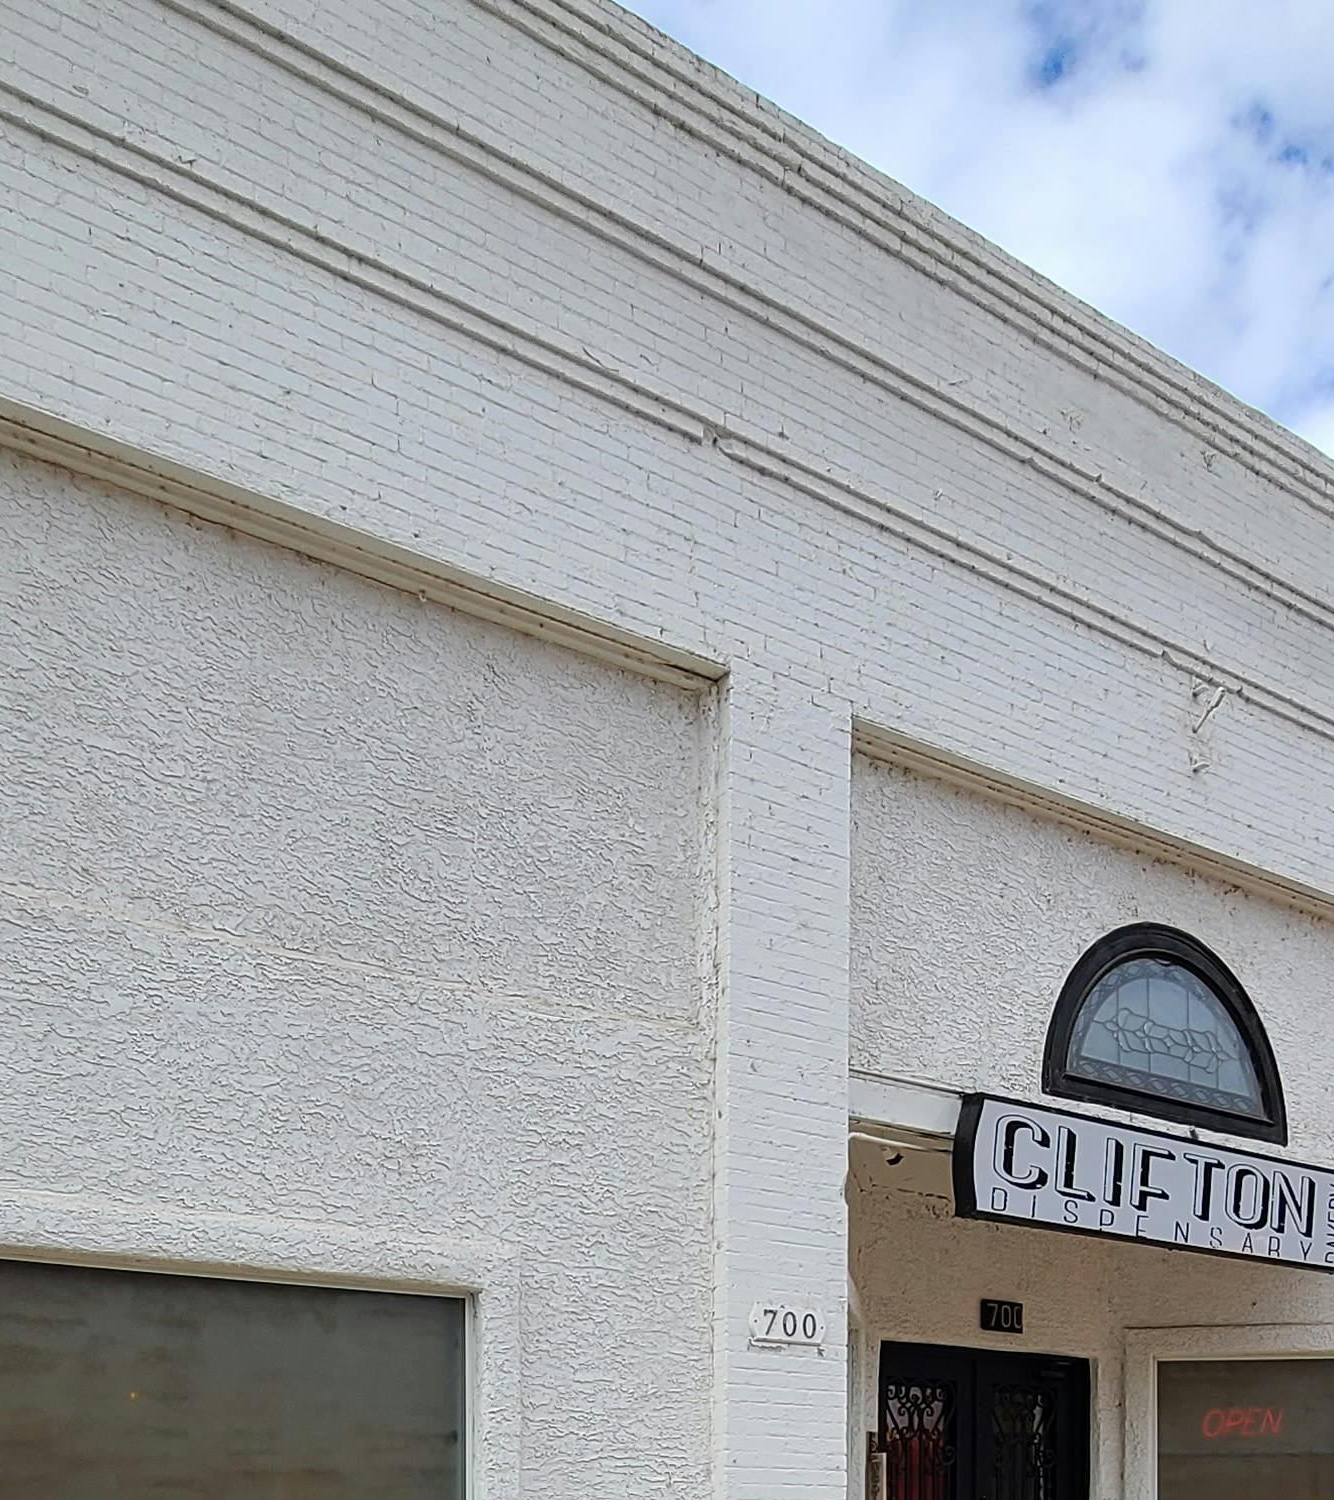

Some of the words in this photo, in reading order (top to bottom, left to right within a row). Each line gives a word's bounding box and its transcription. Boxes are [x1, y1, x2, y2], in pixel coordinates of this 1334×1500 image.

[992, 1113, 1317, 1239] CLIFTON
[990, 1186, 1313, 1261] DISPENSARY
[763, 1308, 817, 1339] 700
[987, 1303, 1023, 1328] 700
[1200, 1408, 1285, 1440] OPEN
